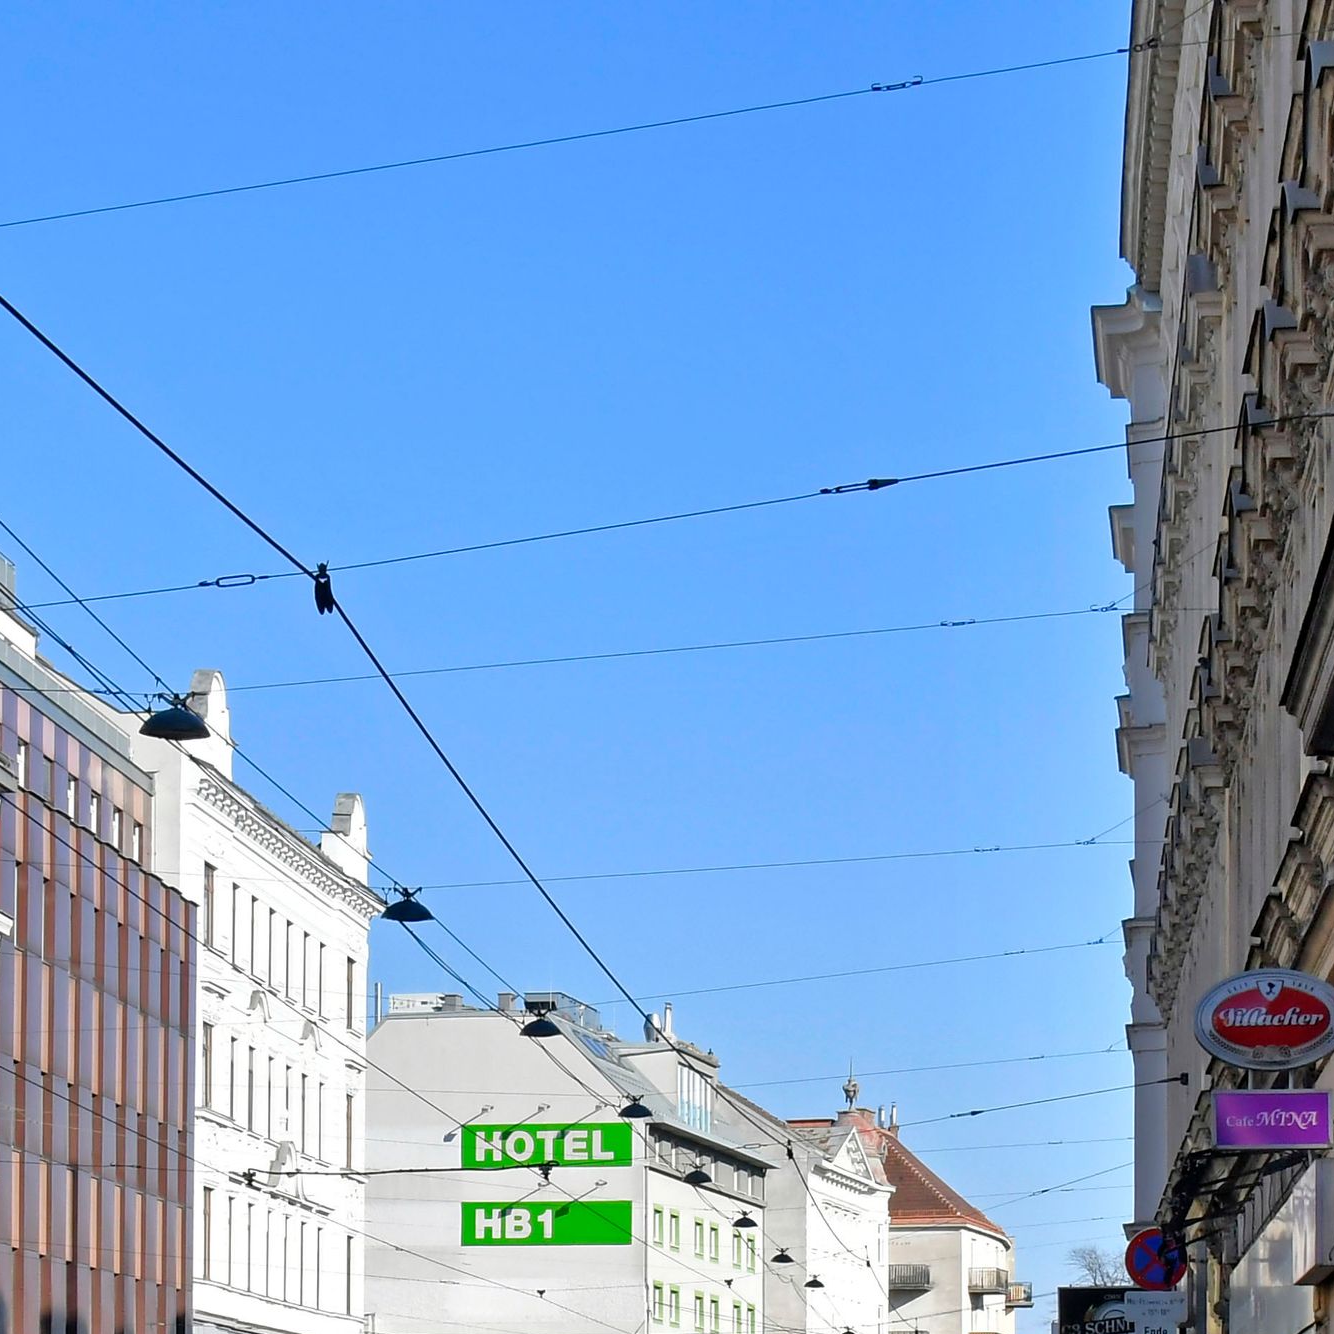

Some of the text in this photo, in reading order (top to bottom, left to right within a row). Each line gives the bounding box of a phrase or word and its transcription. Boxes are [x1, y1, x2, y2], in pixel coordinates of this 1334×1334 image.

[1219, 1007, 1323, 1027] Villacher
[1226, 1109, 1318, 1130] Cafe MINA
[475, 1130, 614, 1162] HOTEL
[474, 1208, 553, 1239] HB1
